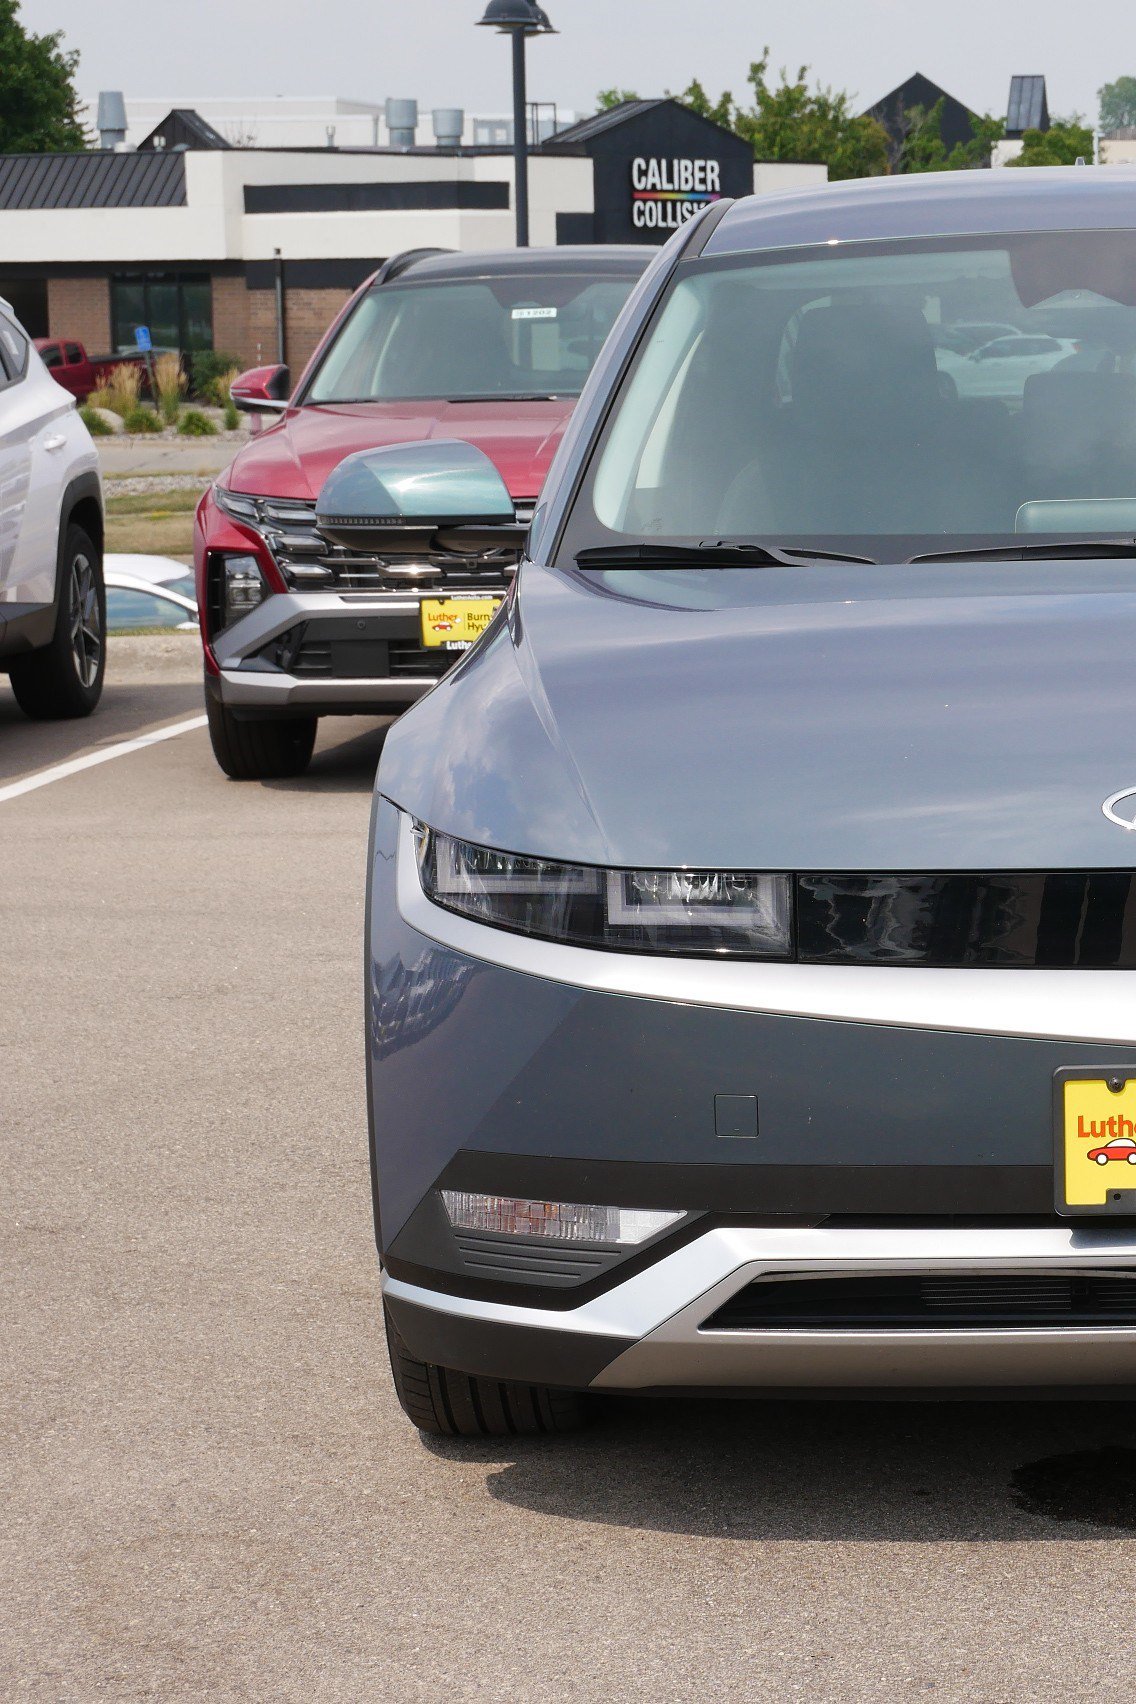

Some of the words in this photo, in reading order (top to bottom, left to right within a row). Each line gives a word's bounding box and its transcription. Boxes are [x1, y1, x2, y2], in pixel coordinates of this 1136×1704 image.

[632, 157, 720, 192] CALIBER
[632, 200, 706, 228] COLLIS
[427, 613, 458, 621] Luther
[467, 612, 493, 621] Burn
